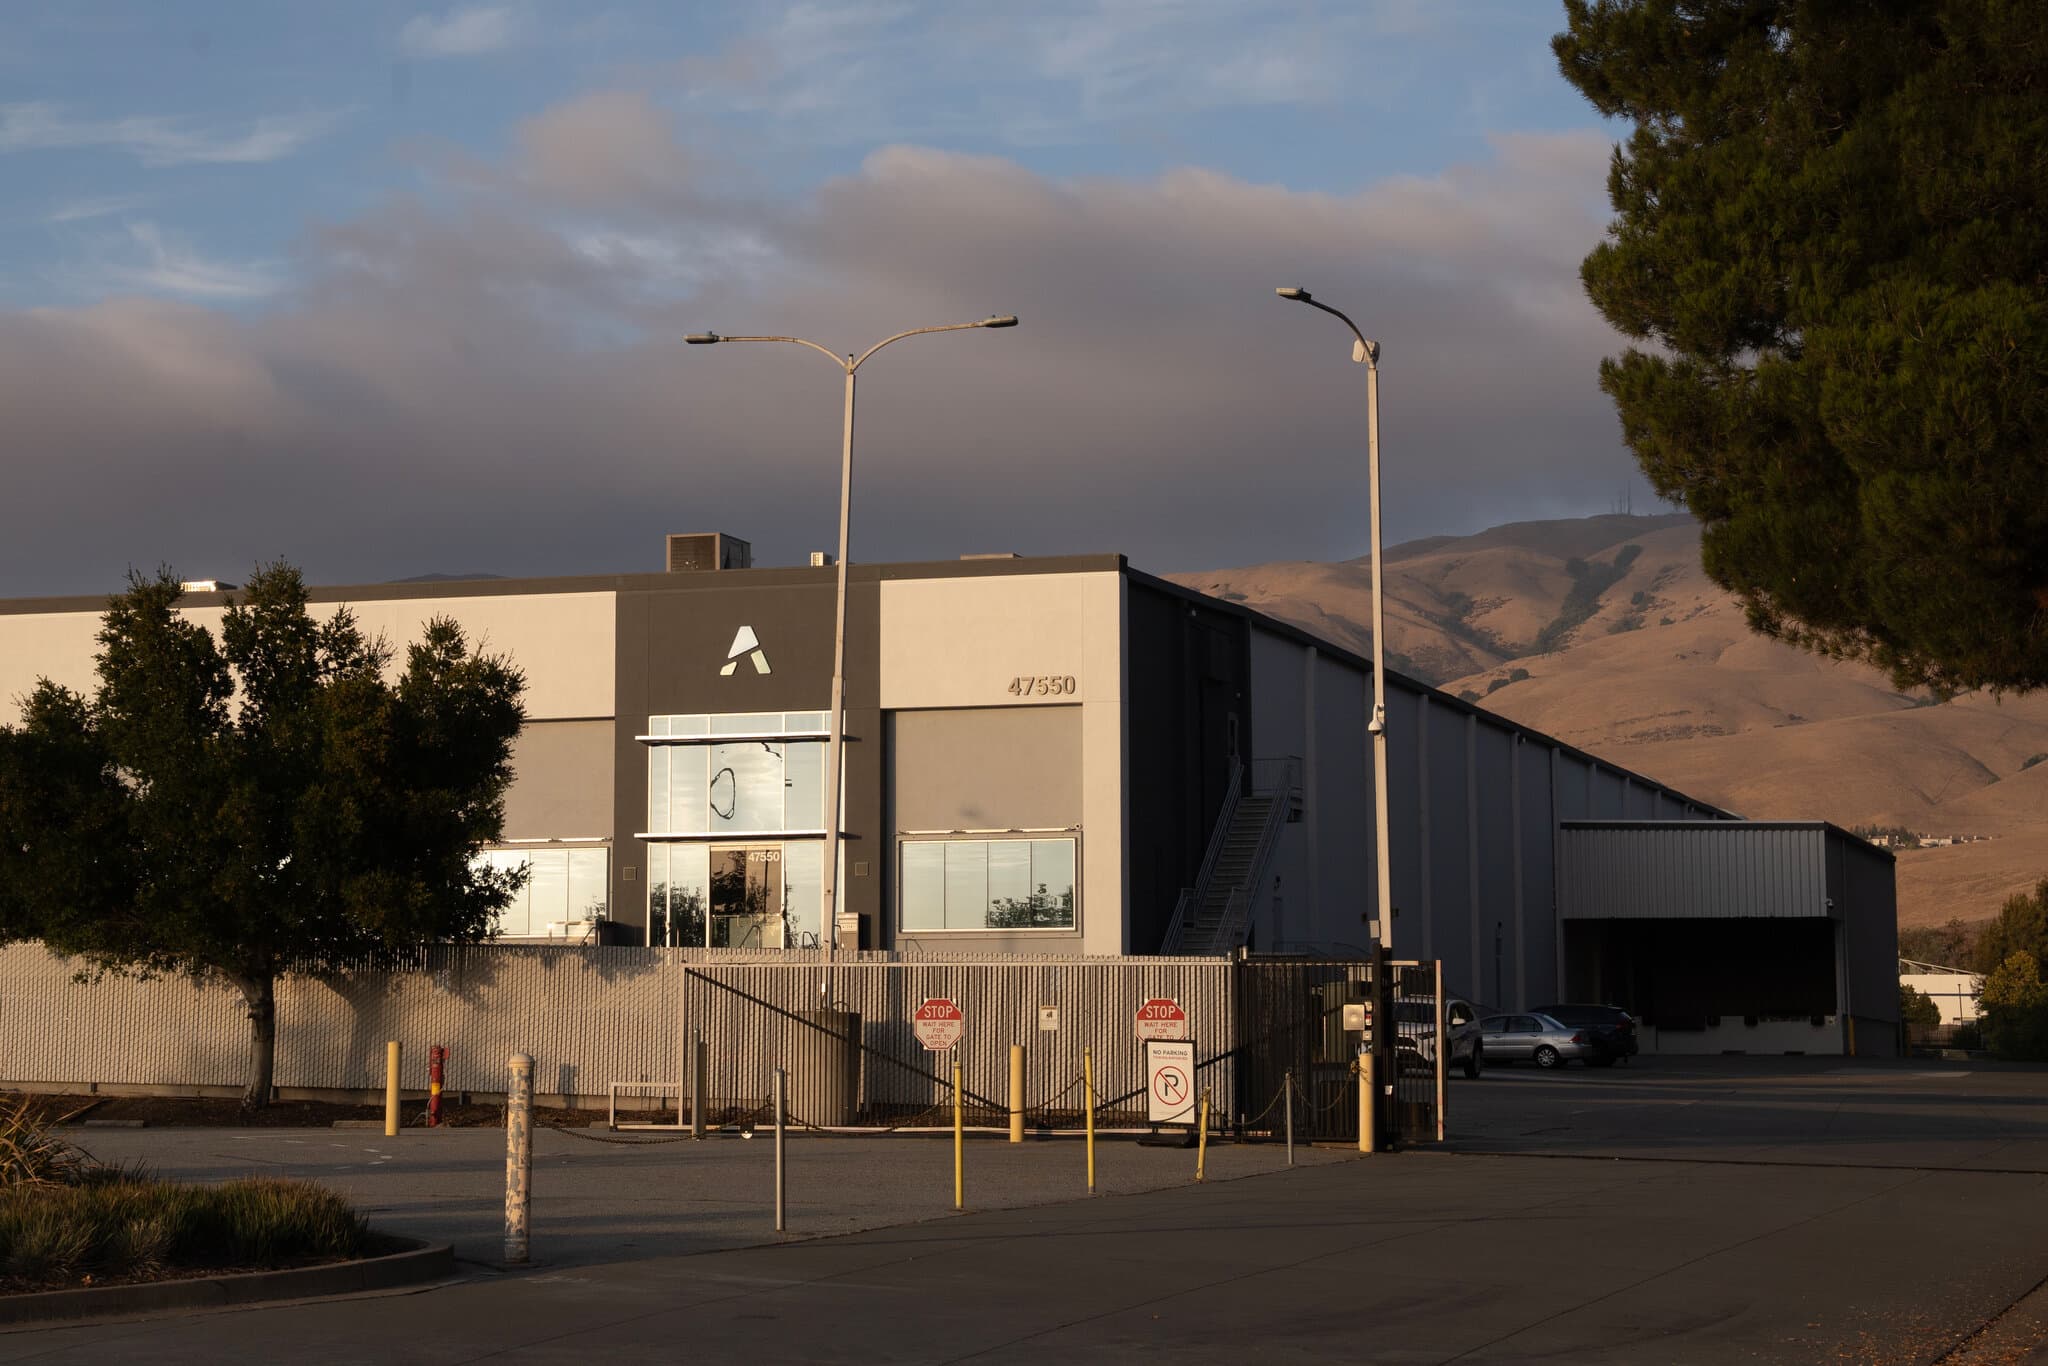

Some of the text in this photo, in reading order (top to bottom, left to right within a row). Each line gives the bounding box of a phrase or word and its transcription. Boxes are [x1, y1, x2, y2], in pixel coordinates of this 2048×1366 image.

[1008, 675, 1076, 696] 47550
[749, 851, 780, 862] 47550
[924, 1005, 953, 1018] STOP
[1146, 1005, 1176, 1018] STOP
